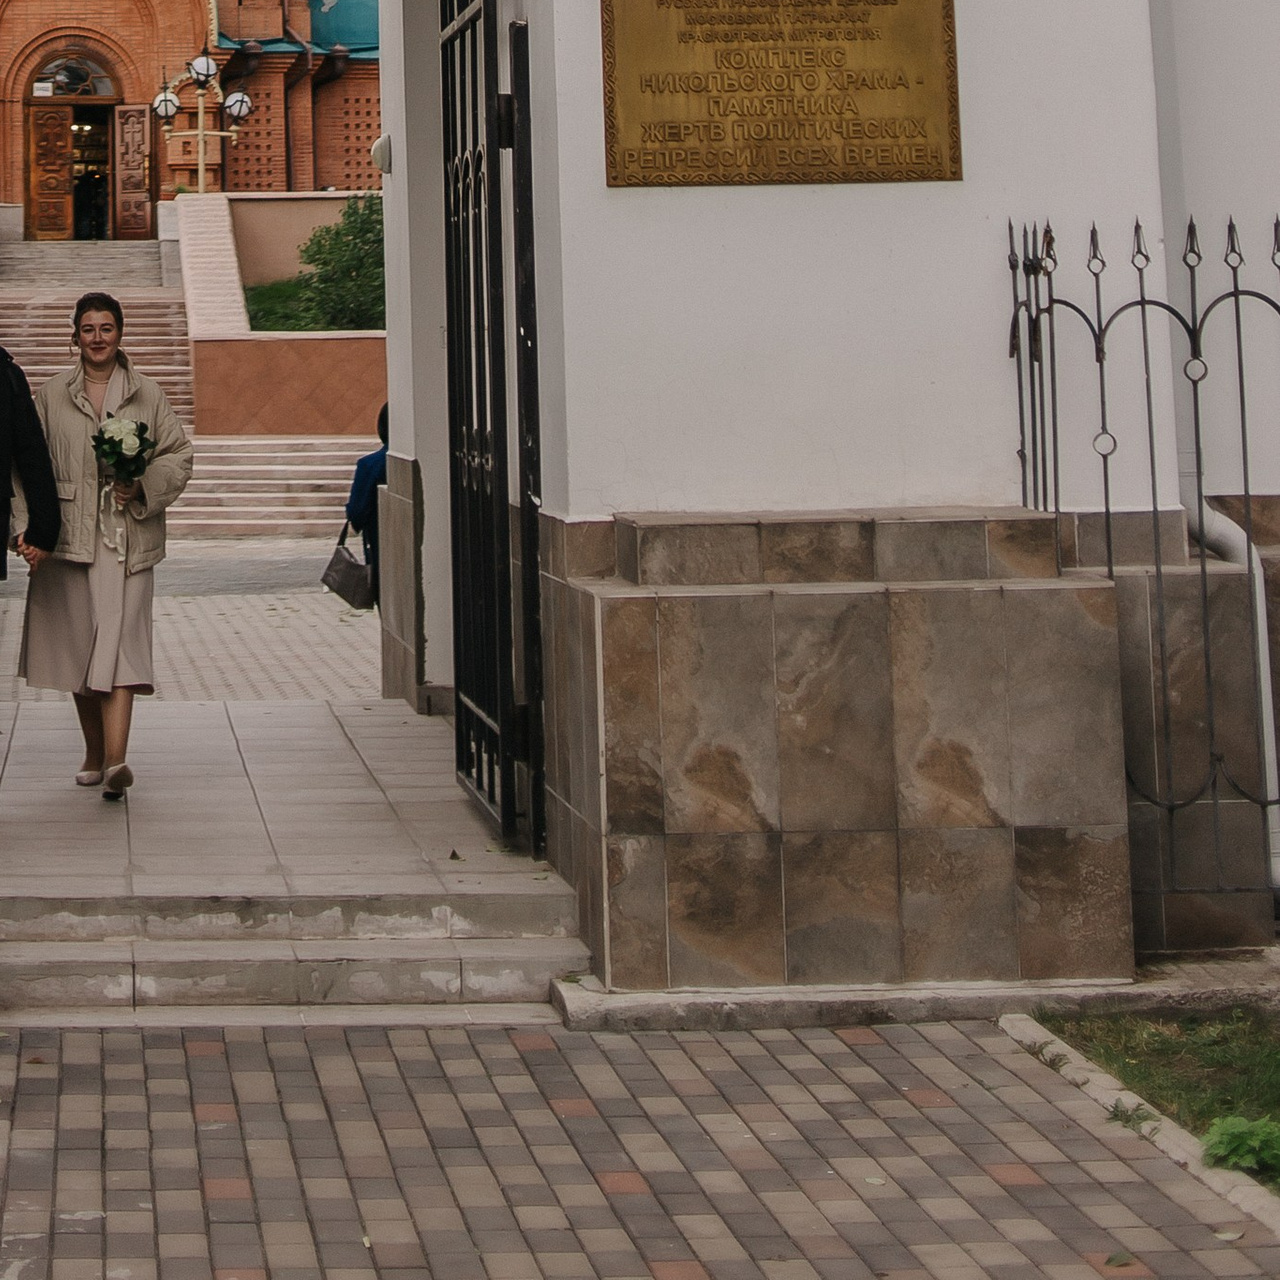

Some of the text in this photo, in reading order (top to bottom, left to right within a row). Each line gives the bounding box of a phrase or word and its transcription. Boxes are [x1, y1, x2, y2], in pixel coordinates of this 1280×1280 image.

[784, 11, 871, 25] ПАТРИАРХАТ
[677, 28, 882, 44] КРАСНОЯРСКАЯ МИТРОПОЛИЯ
[715, 49, 846, 70] КОМПЛЕКС
[640, 71, 820, 94] НИКОЛЬСКОГО
[826, 69, 910, 91] ХРАМА
[708, 95, 859, 117] ПАМЯТНИКА
[640, 118, 927, 143] ЖЕРТВ ПОЛИТИЧЕСКИХ
[624, 143, 943, 170] РЕПРЕССИЙ ВСЕХ ВРЕМЕН
